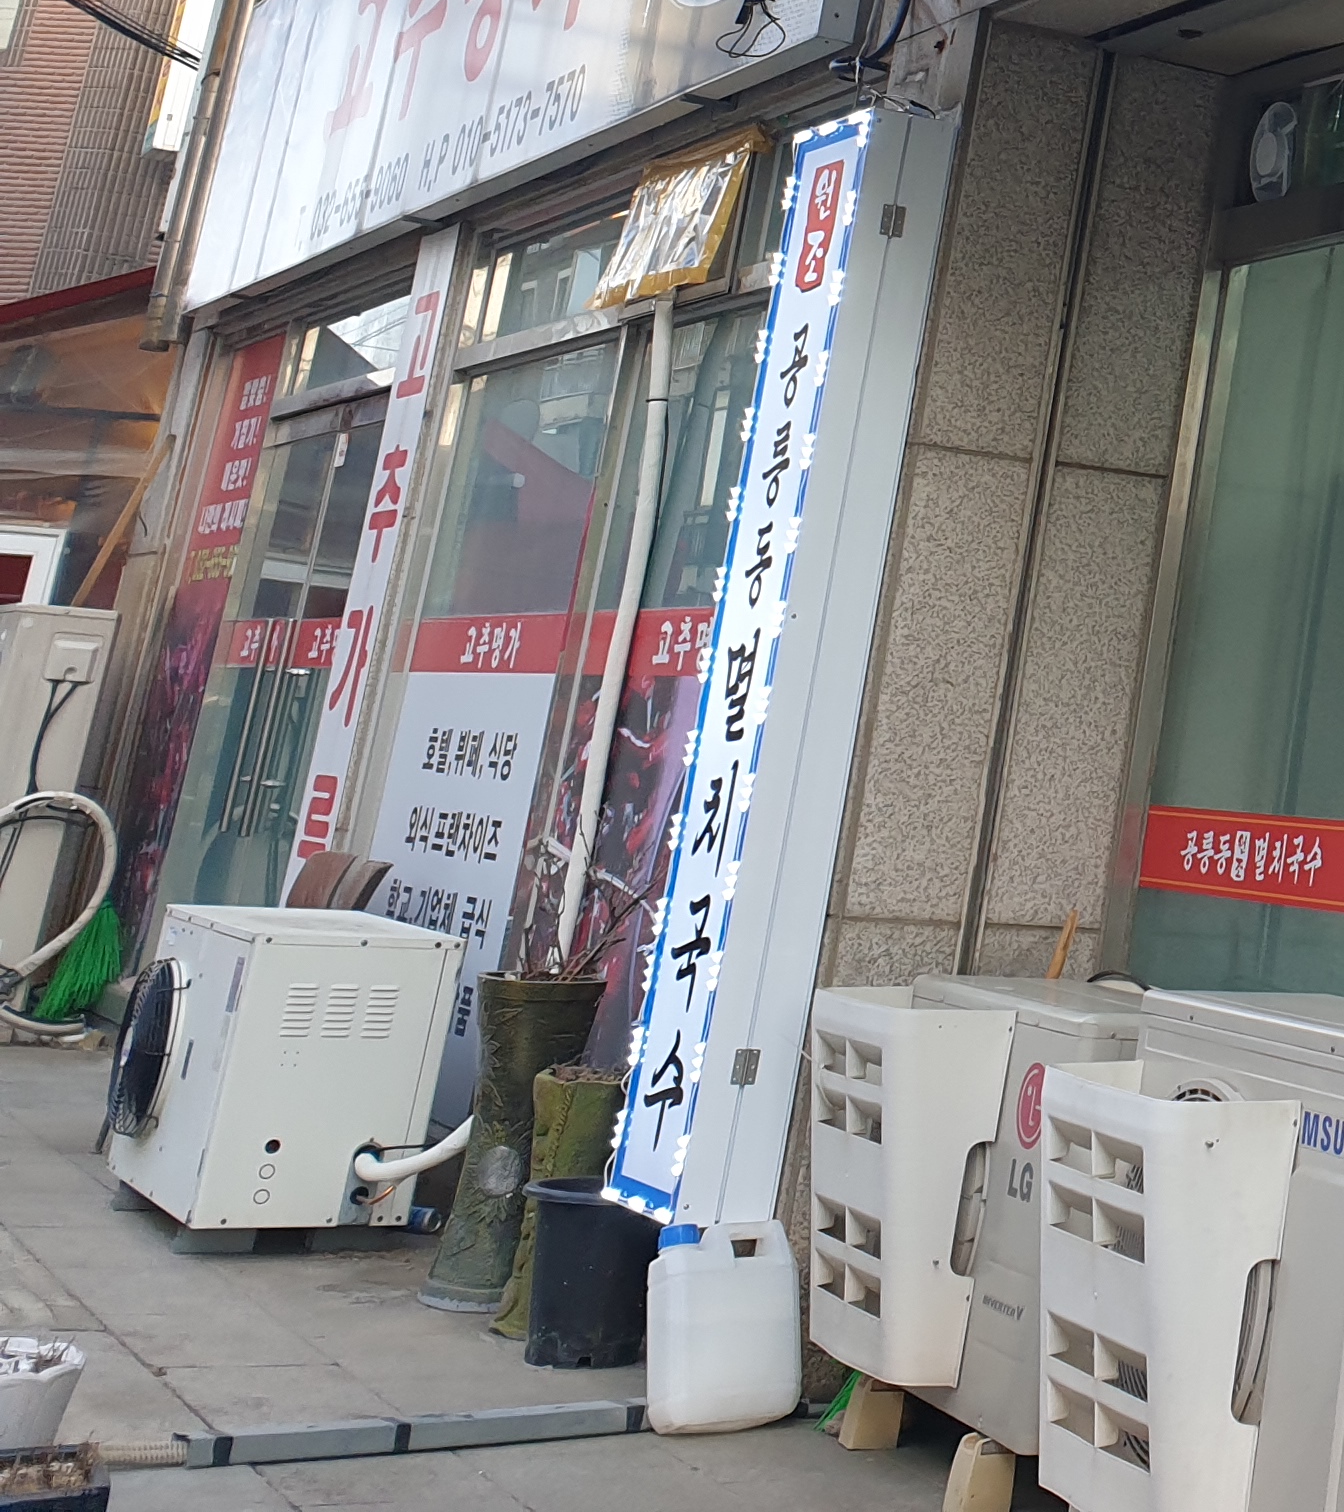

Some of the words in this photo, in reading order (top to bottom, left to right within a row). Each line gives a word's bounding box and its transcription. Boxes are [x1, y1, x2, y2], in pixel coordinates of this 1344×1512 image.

[452, 63, 587, 177] 010-5173-7570
[803, 160, 843, 290] 원조
[742, 320, 810, 605] 공릉동
[460, 621, 522, 669] 고추명가
[643, 633, 761, 1152] 멸치국수
[1180, 829, 1232, 878] 공릉동
[1254, 831, 1325, 888] 멸치국수
[459, 896, 493, 951] 급식
[1008, 1157, 1034, 1204] LG
